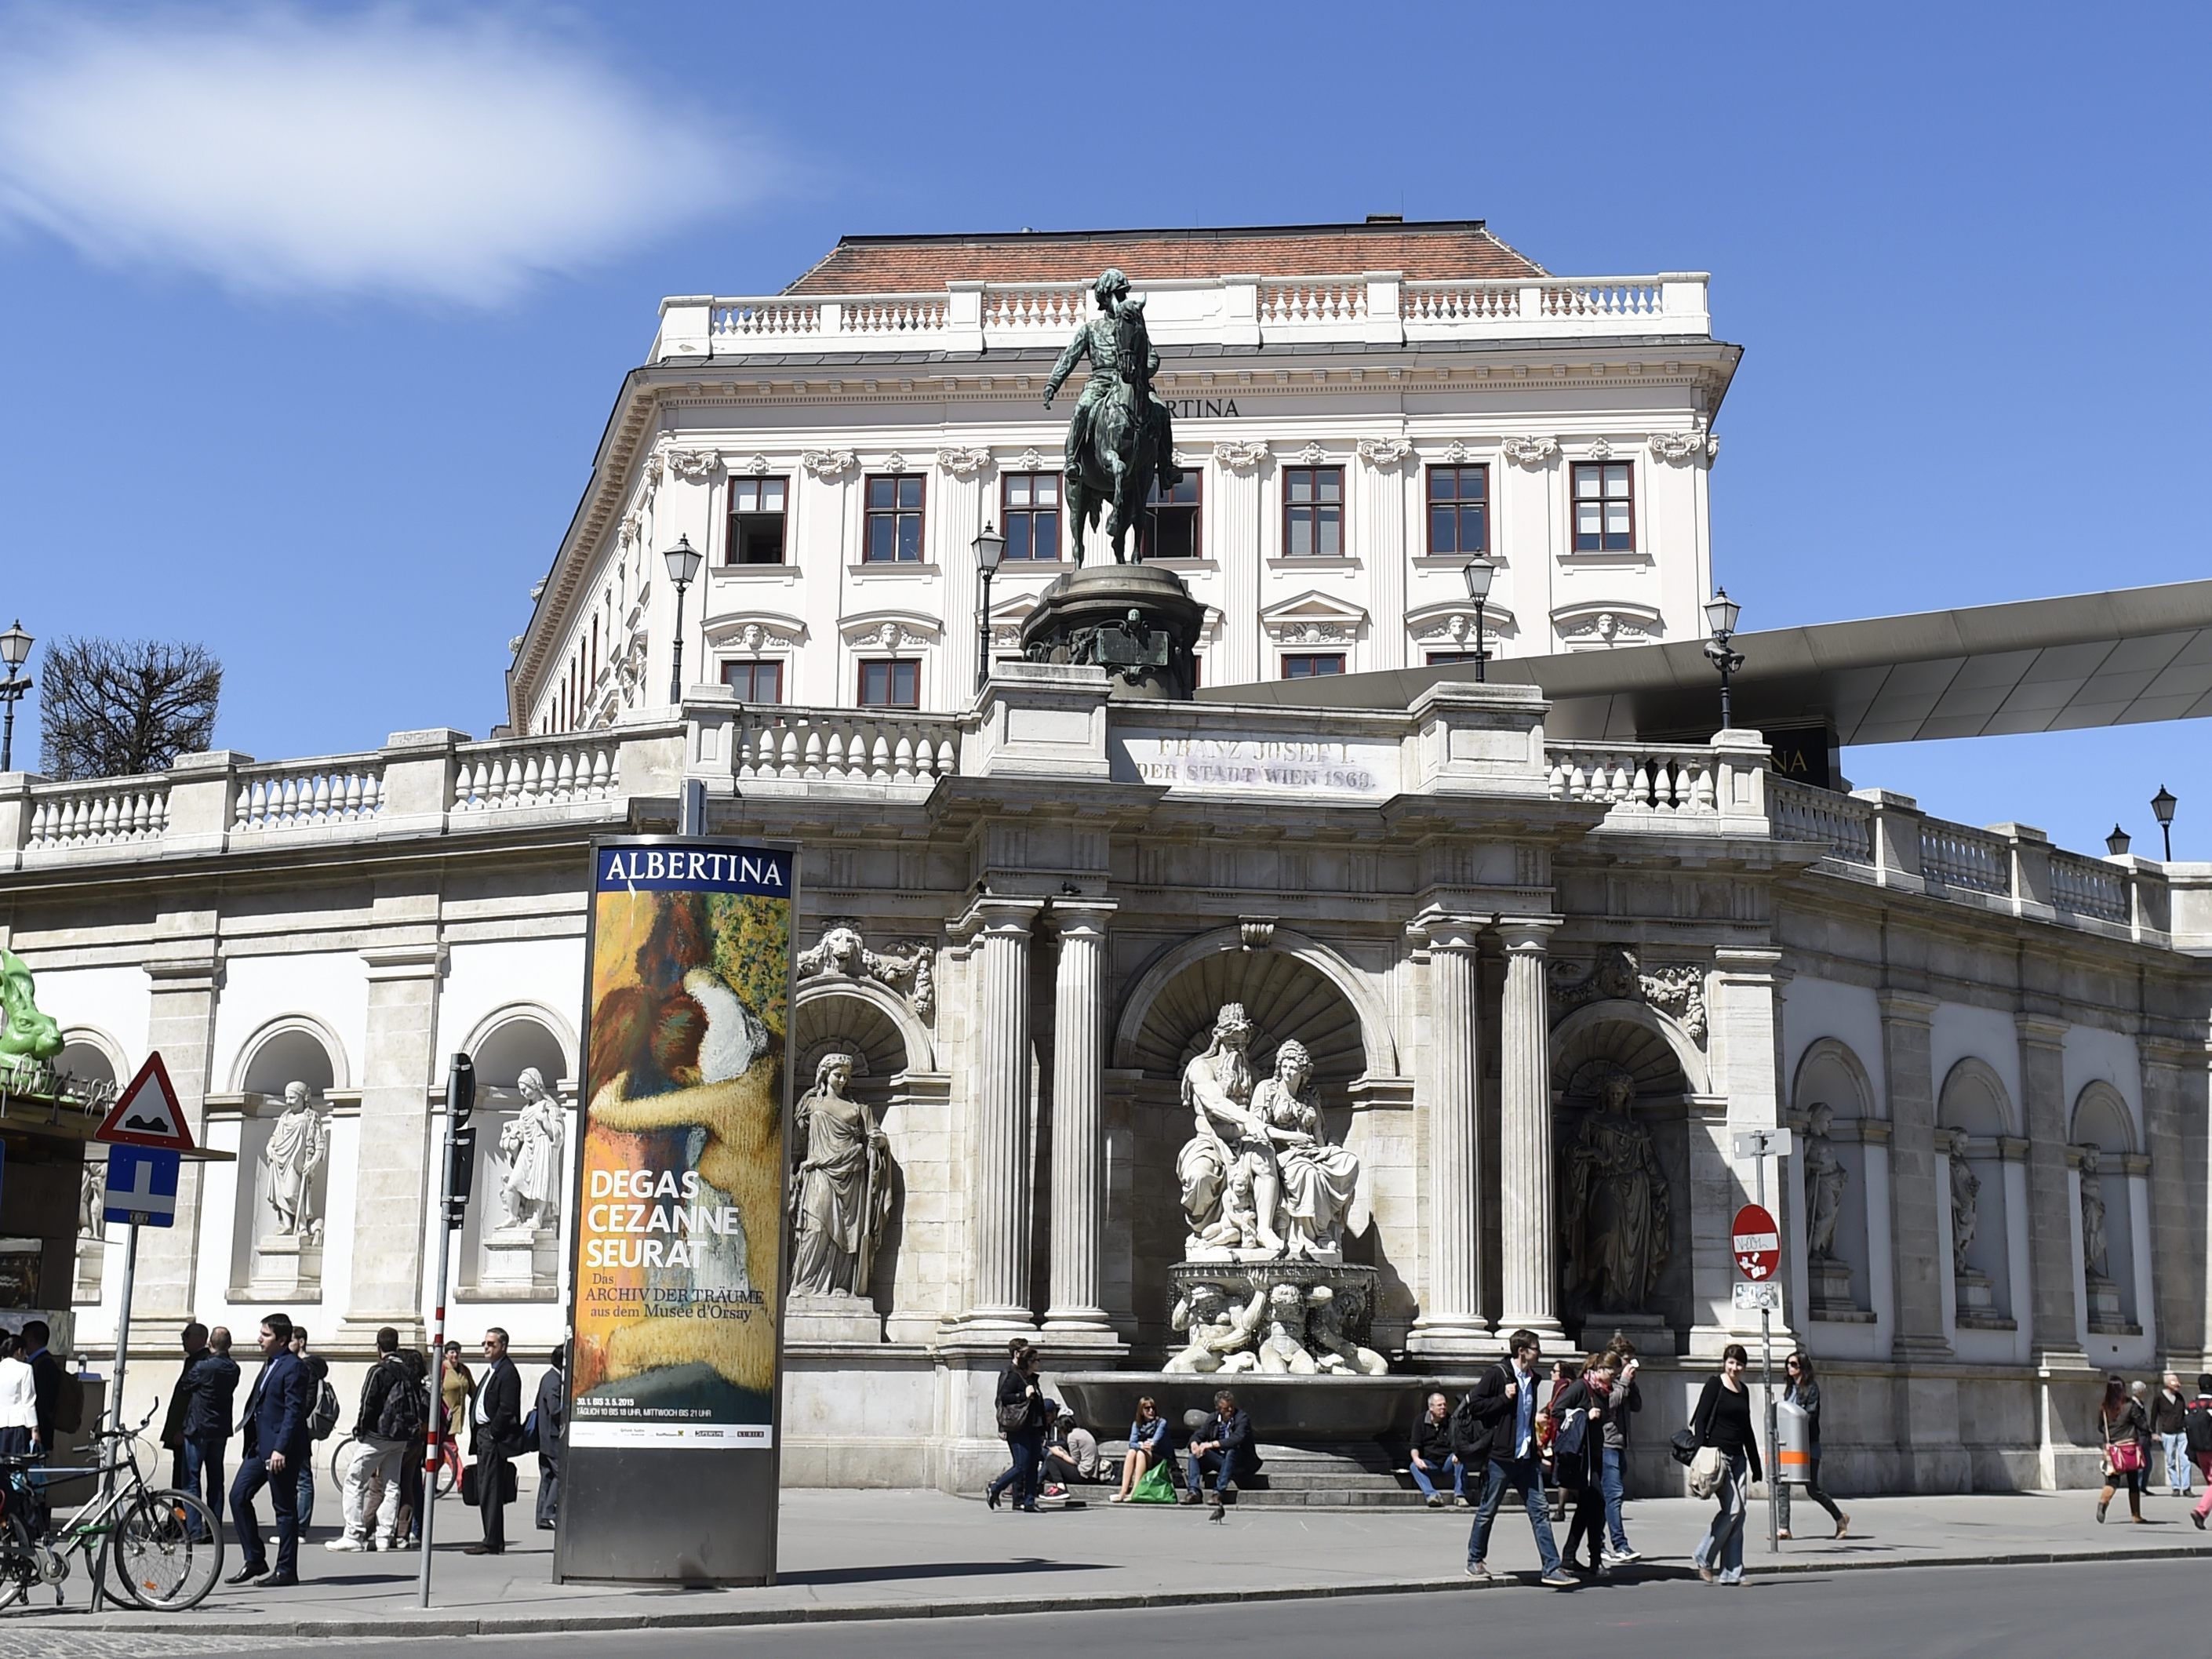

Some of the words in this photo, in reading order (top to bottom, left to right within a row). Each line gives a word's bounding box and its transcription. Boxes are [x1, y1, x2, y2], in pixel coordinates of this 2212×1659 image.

[1186, 766, 1255, 783] STADT
[1264, 768, 1318, 785] WIEN
[605, 852, 784, 886] ALBERTINA
[590, 1170, 699, 1199] DEGAS
[588, 1204, 739, 1235] CEZANNE
[586, 1239, 708, 1268] SEURAT
[592, 1273, 614, 1285] Das
[585, 1288, 649, 1301] ARCHIV
[653, 1289, 689, 1301] DER
[693, 1286, 765, 1304] TRÄUME
[591, 1307, 610, 1317] aus
[613, 1305, 639, 1318] dem
[644, 1304, 693, 1319] Musée
